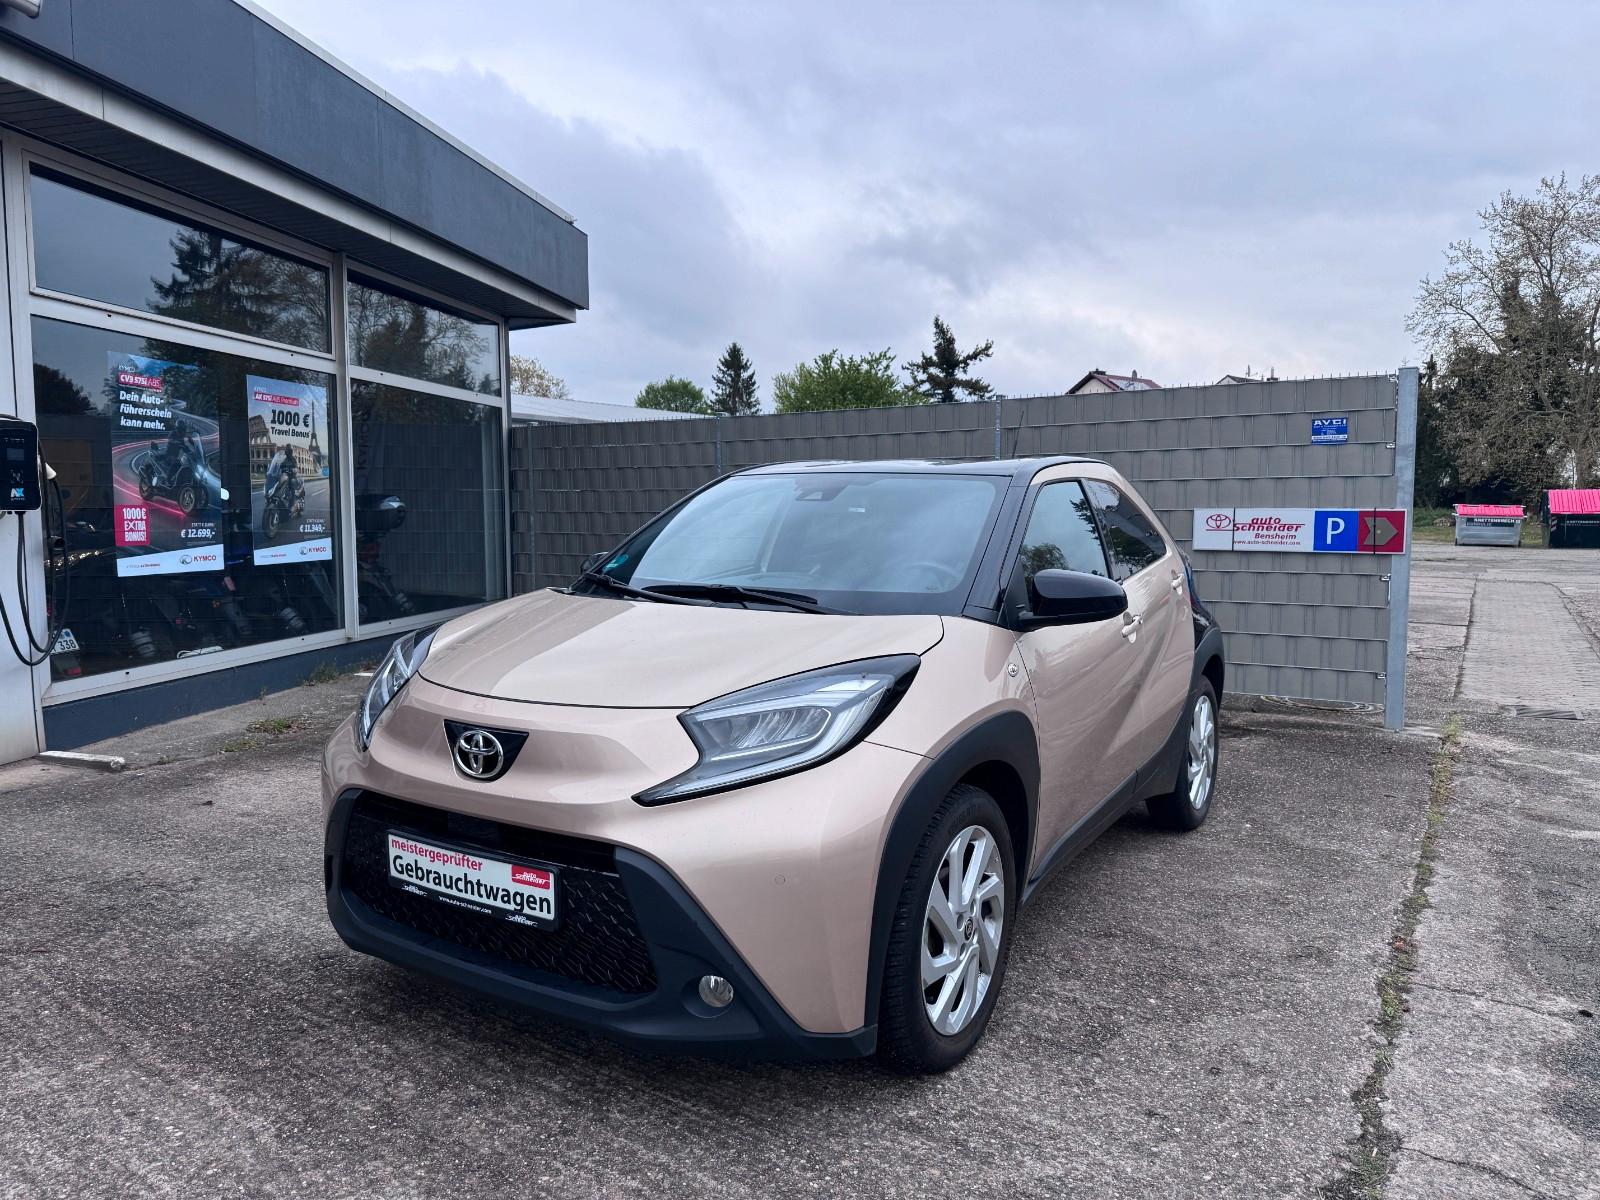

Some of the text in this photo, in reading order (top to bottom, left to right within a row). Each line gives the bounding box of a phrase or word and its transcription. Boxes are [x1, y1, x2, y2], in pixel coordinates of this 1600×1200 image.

[120, 374, 133, 383] CV3
[119, 390, 164, 405] Dein Auto-
[120, 403, 172, 419] führerschein
[120, 416, 166, 430] kann mehr.
[270, 409, 310, 428] 1000 €
[270, 426, 290, 437] Travel
[122, 507, 147, 520] 1000 €
[124, 520, 146, 531] EXTRA
[1251, 516, 1281, 525] auto
[181, 528, 216, 539] € 12.699,-
[299, 524, 304, 533] €
[1326, 517, 1345, 545] P
[124, 531, 147, 542] BONUS!
[1254, 532, 1297, 540] Bensheim
[193, 554, 217, 563] KYMCO
[58, 639, 77, 651] 338
[391, 838, 483, 872] meistergeprüfter
[392, 855, 552, 915] Gebrauchtwagen
